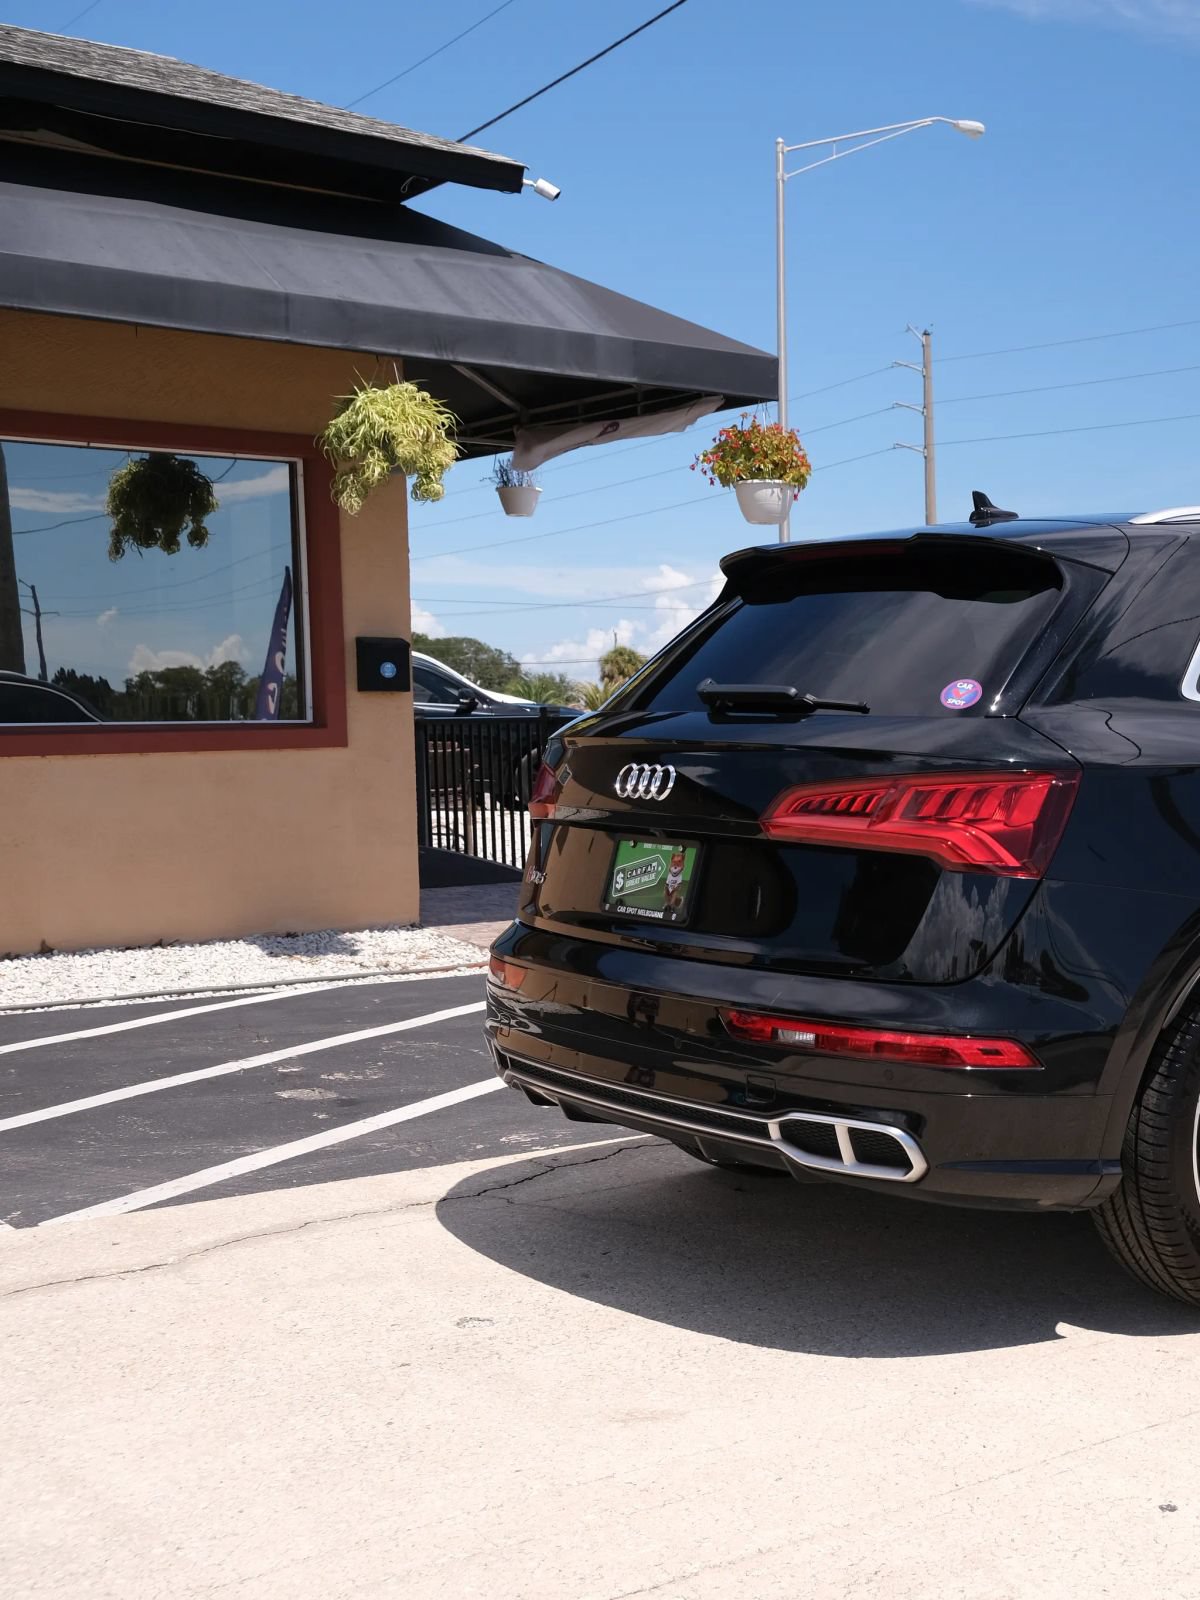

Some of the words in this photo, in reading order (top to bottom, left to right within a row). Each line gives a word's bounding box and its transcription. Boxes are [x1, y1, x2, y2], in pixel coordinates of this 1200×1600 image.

[956, 682, 974, 690] CAR
[946, 698, 966, 707] SPOT
[617, 905, 626, 913] CAR
[626, 906, 638, 915] SPOT
[637, 908, 664, 919] MELBOURNE
